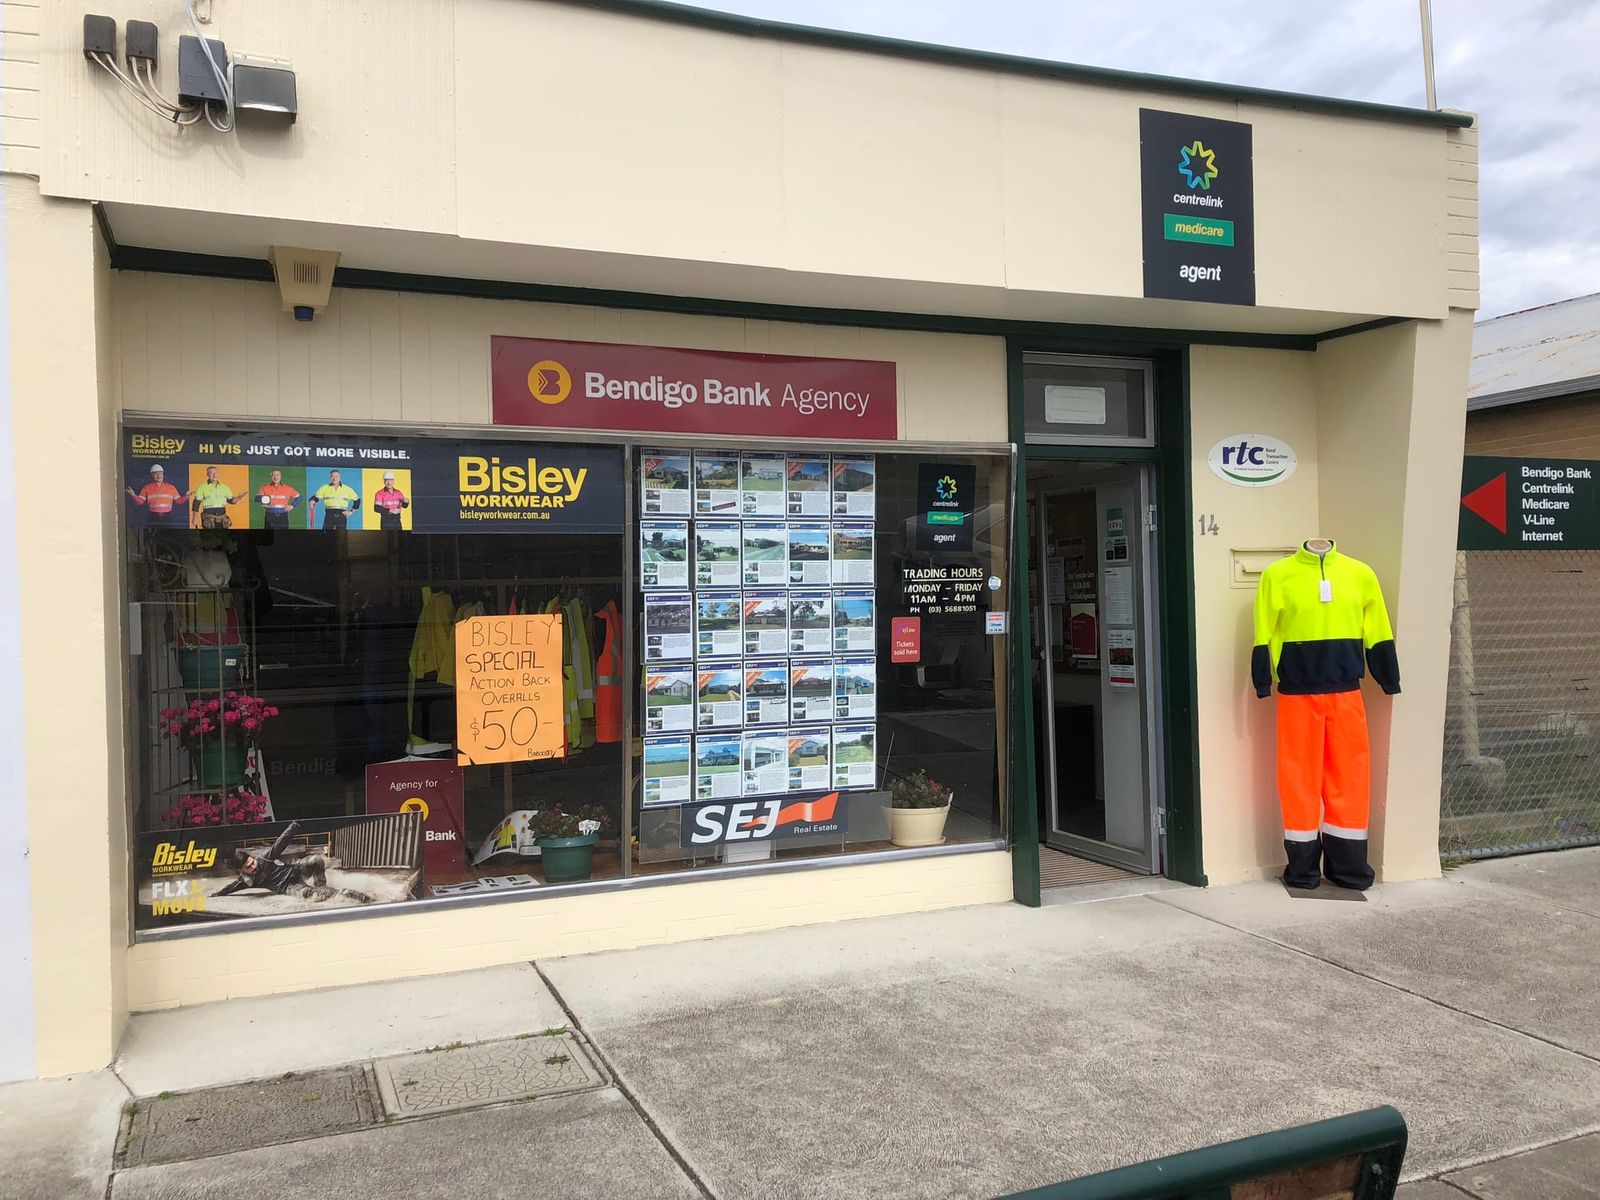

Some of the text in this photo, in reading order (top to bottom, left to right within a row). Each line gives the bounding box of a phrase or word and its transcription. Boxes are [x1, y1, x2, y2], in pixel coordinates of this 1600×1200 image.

[1173, 193, 1224, 208] centrelink
[1175, 221, 1224, 237] medicare
[1179, 264, 1222, 283] agent
[585, 371, 870, 417] Bendigo Bank Agency
[131, 434, 185, 452] Bisley
[199, 444, 410, 460] HI VIS JUST GOT MORE VISIBLE.
[1222, 442, 1264, 465] rtc
[458, 456, 588, 502] Bisley
[1521, 466, 1591, 480] Bendigo Bank
[1522, 482, 1574, 494] Centrelink
[459, 494, 564, 508] WORKWEAR
[1522, 498, 1570, 509] Medicare
[460, 510, 550, 521] bisleyworkwear.com.au
[1523, 514, 1555, 525] V-Line
[1198, 514, 1219, 536] 14
[933, 534, 956, 543] agent
[1522, 530, 1563, 541] Internet
[903, 568, 983, 579] TRADING HOURS
[904, 584, 941, 593] MONDAY
[955, 583, 983, 592] FRIDAY
[928, 606, 941, 614] (03)
[472, 618, 555, 647] BISLEY
[465, 650, 544, 673] SPECIAL
[470, 673, 551, 690] ACTION BACK
[481, 691, 541, 706] OVERALLS
[389, 779, 438, 792] Agency for
[690, 800, 782, 844] SEJ
[794, 823, 838, 834] Real Estate
[425, 829, 457, 841] Bank
[152, 840, 218, 868] Bisley
[152, 864, 193, 874] WORKWEAR
